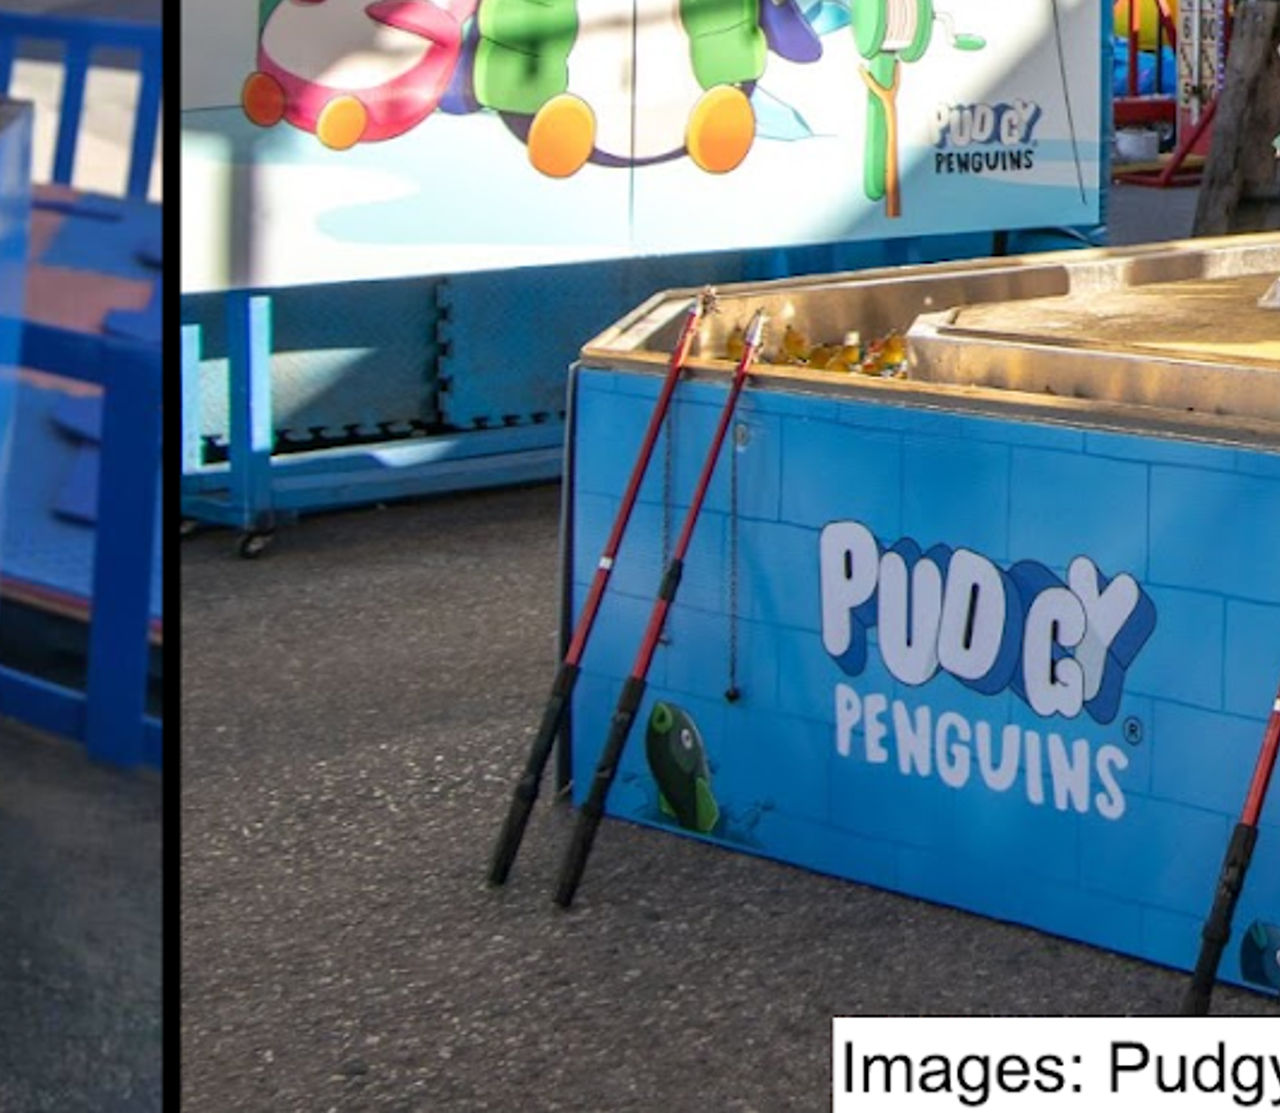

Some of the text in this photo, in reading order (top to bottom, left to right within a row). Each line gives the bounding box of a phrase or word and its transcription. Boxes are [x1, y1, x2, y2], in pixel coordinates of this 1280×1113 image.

[931, 98, 1041, 148] PUDGY
[935, 148, 1034, 174] PENGUINS
[820, 520, 1154, 724] PUDGY
[835, 683, 1130, 820] PENGUINS
